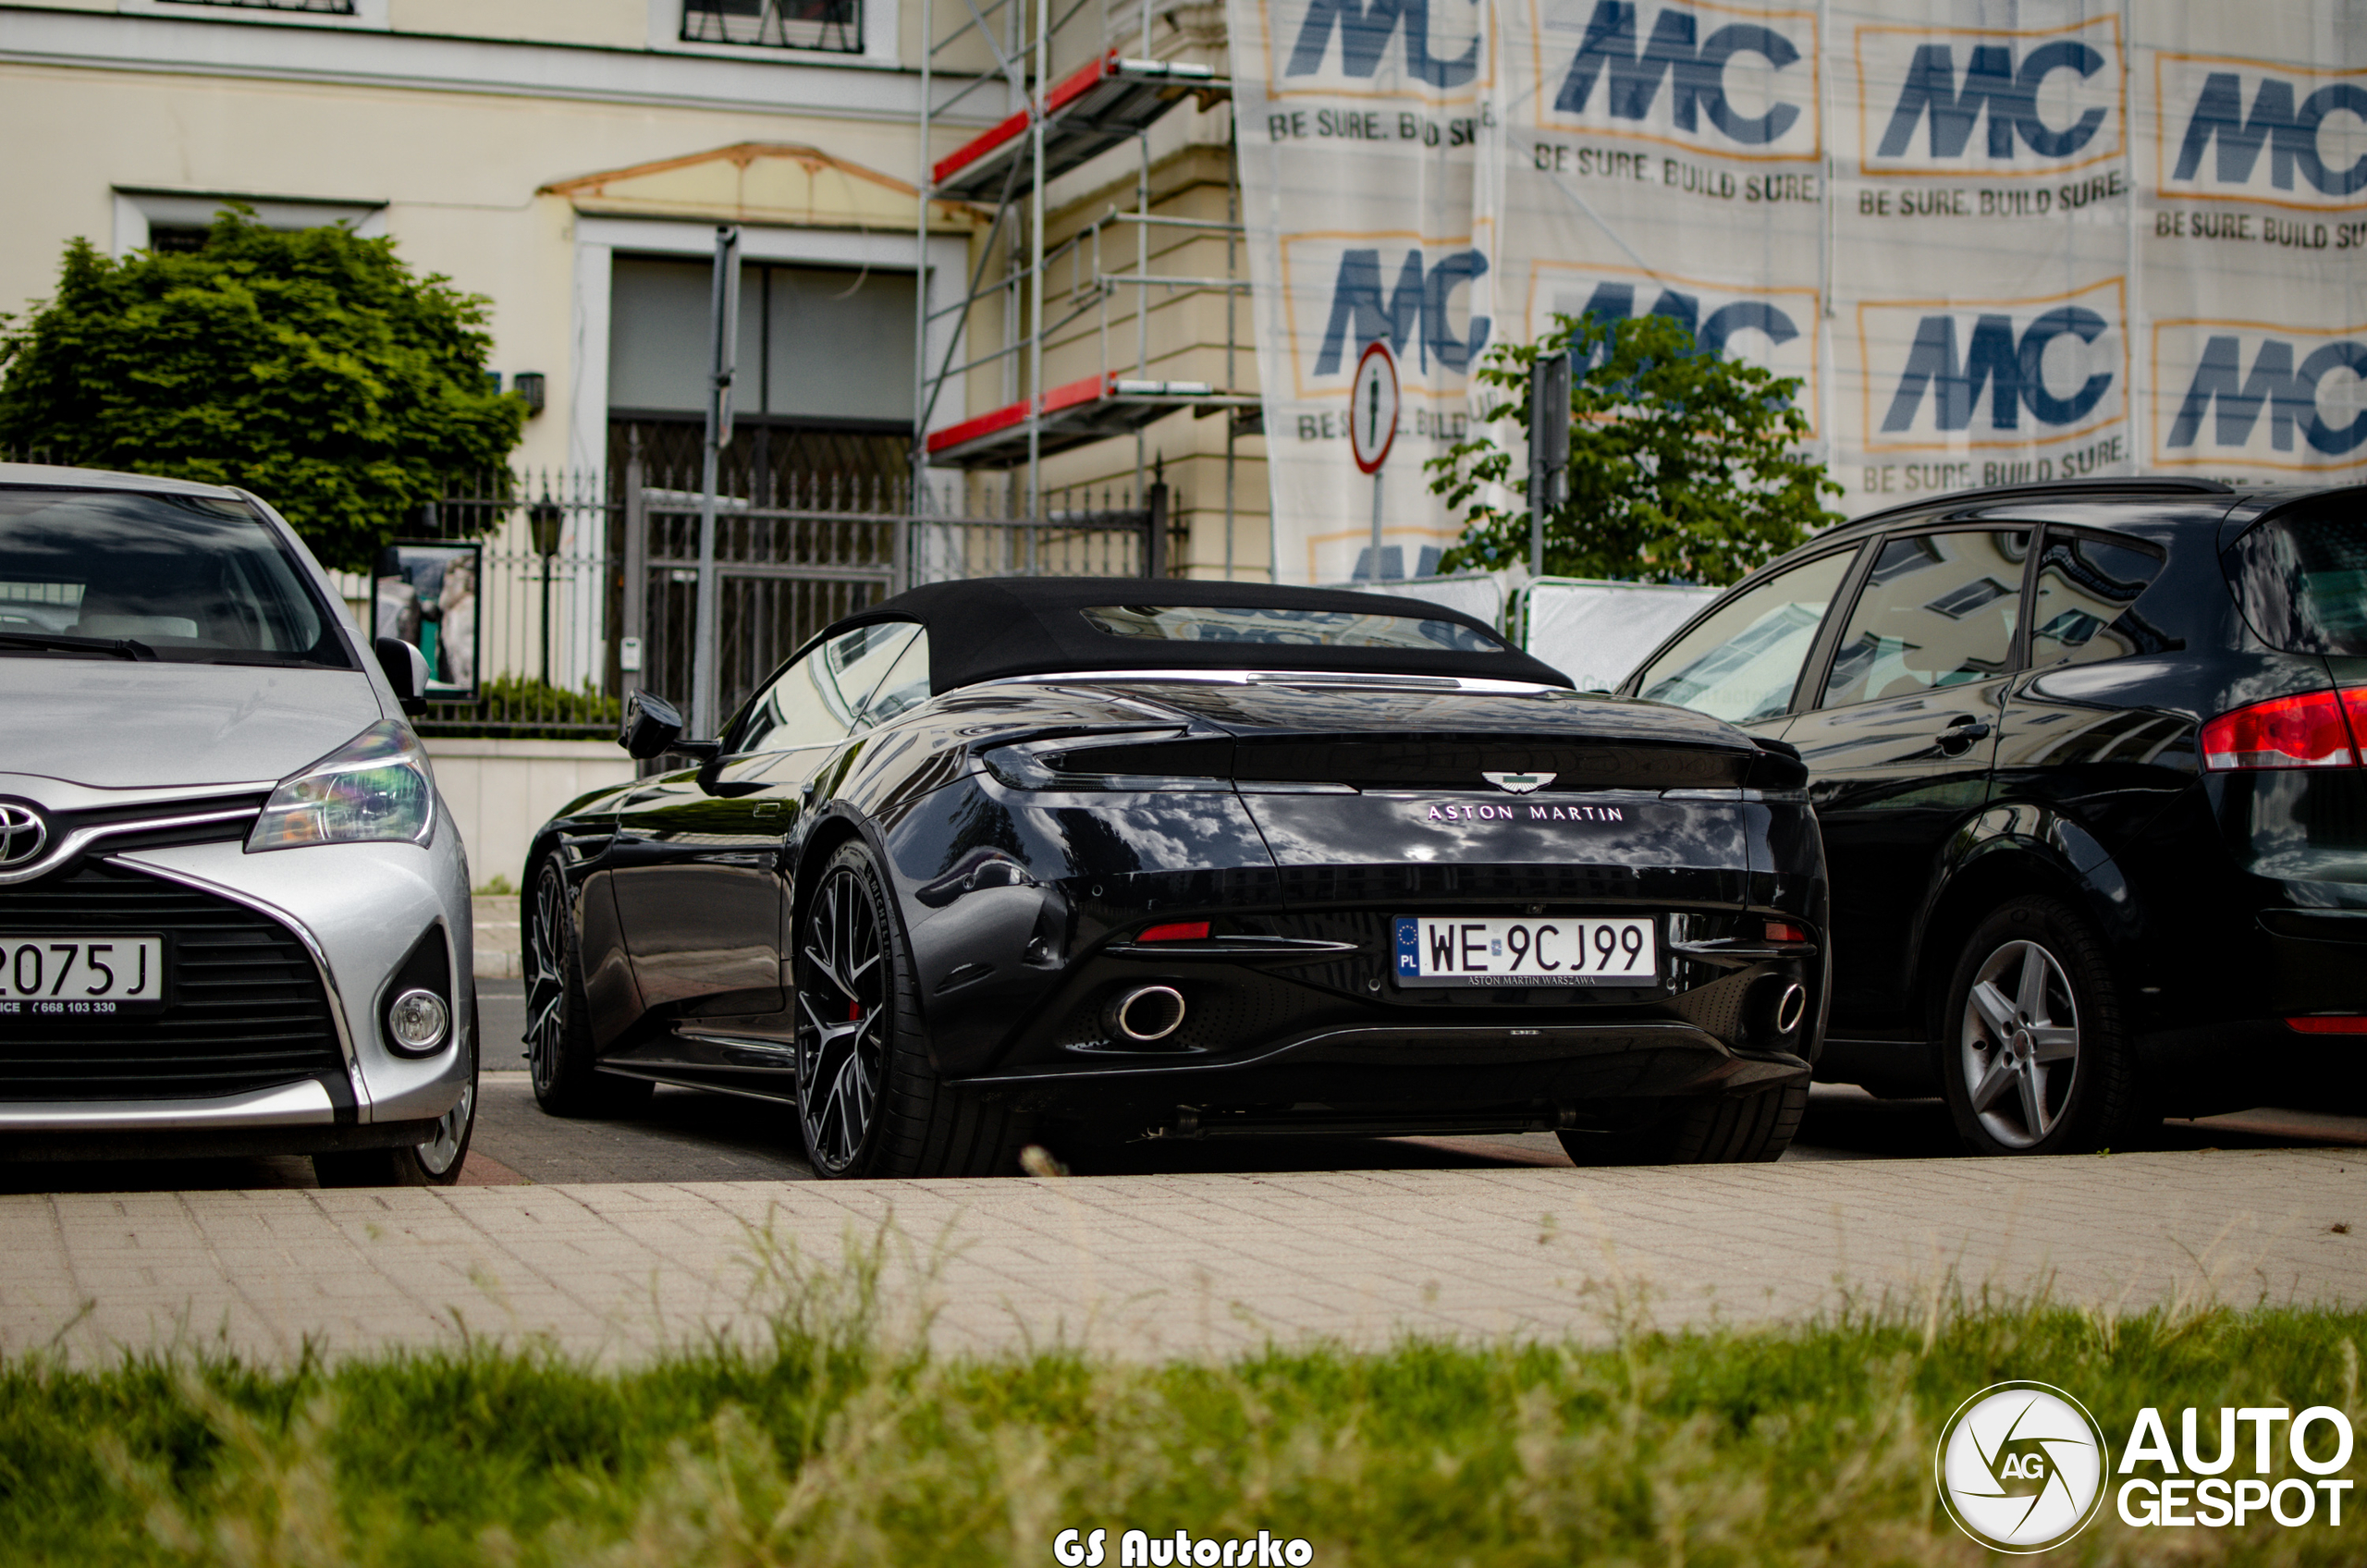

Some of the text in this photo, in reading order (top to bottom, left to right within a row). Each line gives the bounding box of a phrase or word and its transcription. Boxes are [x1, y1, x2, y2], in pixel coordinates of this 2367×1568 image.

[1553, 0, 1801, 144] MC
[1268, 110, 1307, 141] BE
[1318, 109, 1389, 140] SURE.
[1877, 41, 2108, 159] MC
[2173, 72, 2367, 196] MC
[1534, 142, 1821, 203] BE SURE. BUILD SURE.
[1858, 170, 2129, 216] BE SURE. BUILD SURE.
[2155, 211, 2186, 238] BE
[2190, 212, 2257, 241] SURE.
[2263, 216, 2328, 250] BUILD
[1313, 249, 1491, 376] MC
[1880, 306, 2114, 432] MC
[2167, 336, 2367, 456] MC
[1297, 411, 1335, 440] BE
[1863, 435, 2129, 492] BE SURE. BUILD SURE.
[1428, 805, 1623, 822] ASTON MARTIN
[869, 881, 892, 961] MICHELIN
[1429, 924, 1644, 972] WE 9CJ99
[0, 943, 146, 997] 075J
[1401, 955, 1417, 968] PL
[1467, 975, 1596, 986] ASTON MARTIN WARSZAWA
[41, 1002, 64, 1012] 668
[67, 1002, 90, 1012] 103
[93, 1002, 117, 1012] 330
